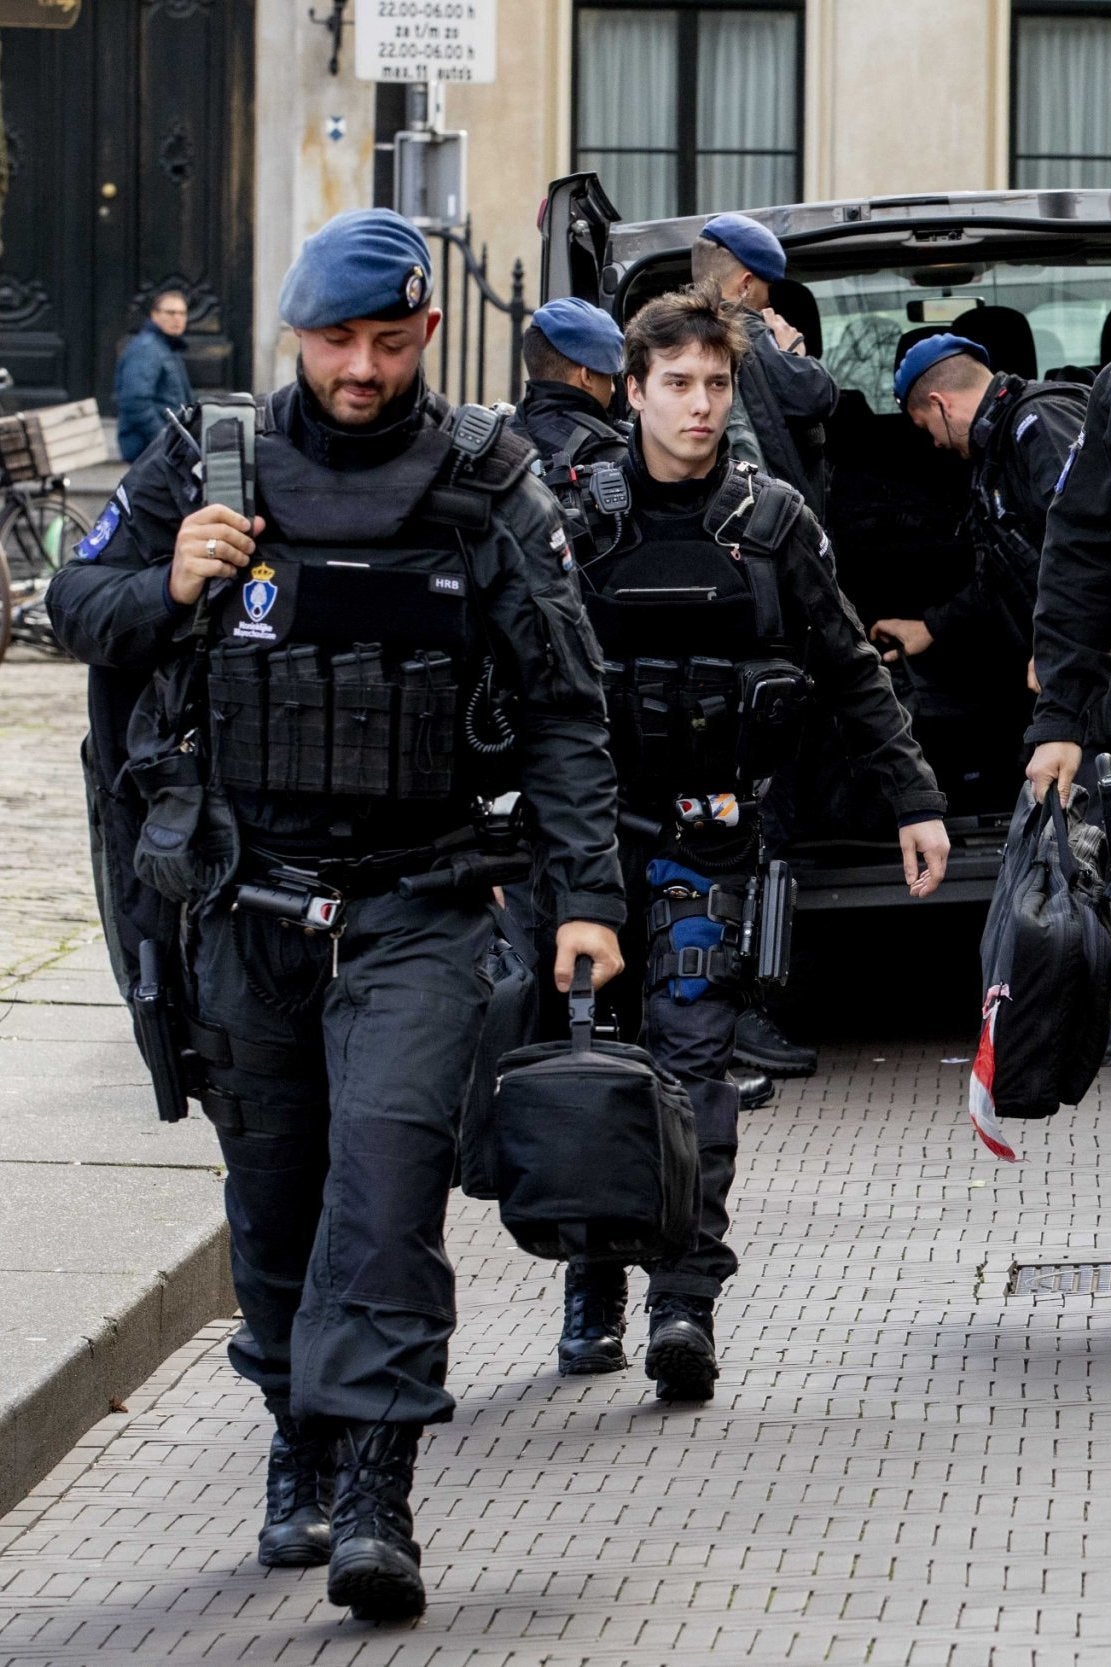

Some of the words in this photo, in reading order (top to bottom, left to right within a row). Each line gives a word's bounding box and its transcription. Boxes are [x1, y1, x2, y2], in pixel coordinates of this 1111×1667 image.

[378, 1, 464, 18] 22.00-06.00
[468, 6, 476, 19] h
[415, 24, 440, 38] t/m
[378, 42, 463, 59] 22.00-06.00
[468, 47, 476, 60] h
[382, 65, 414, 79] max.
[434, 578, 460, 590] HRB
